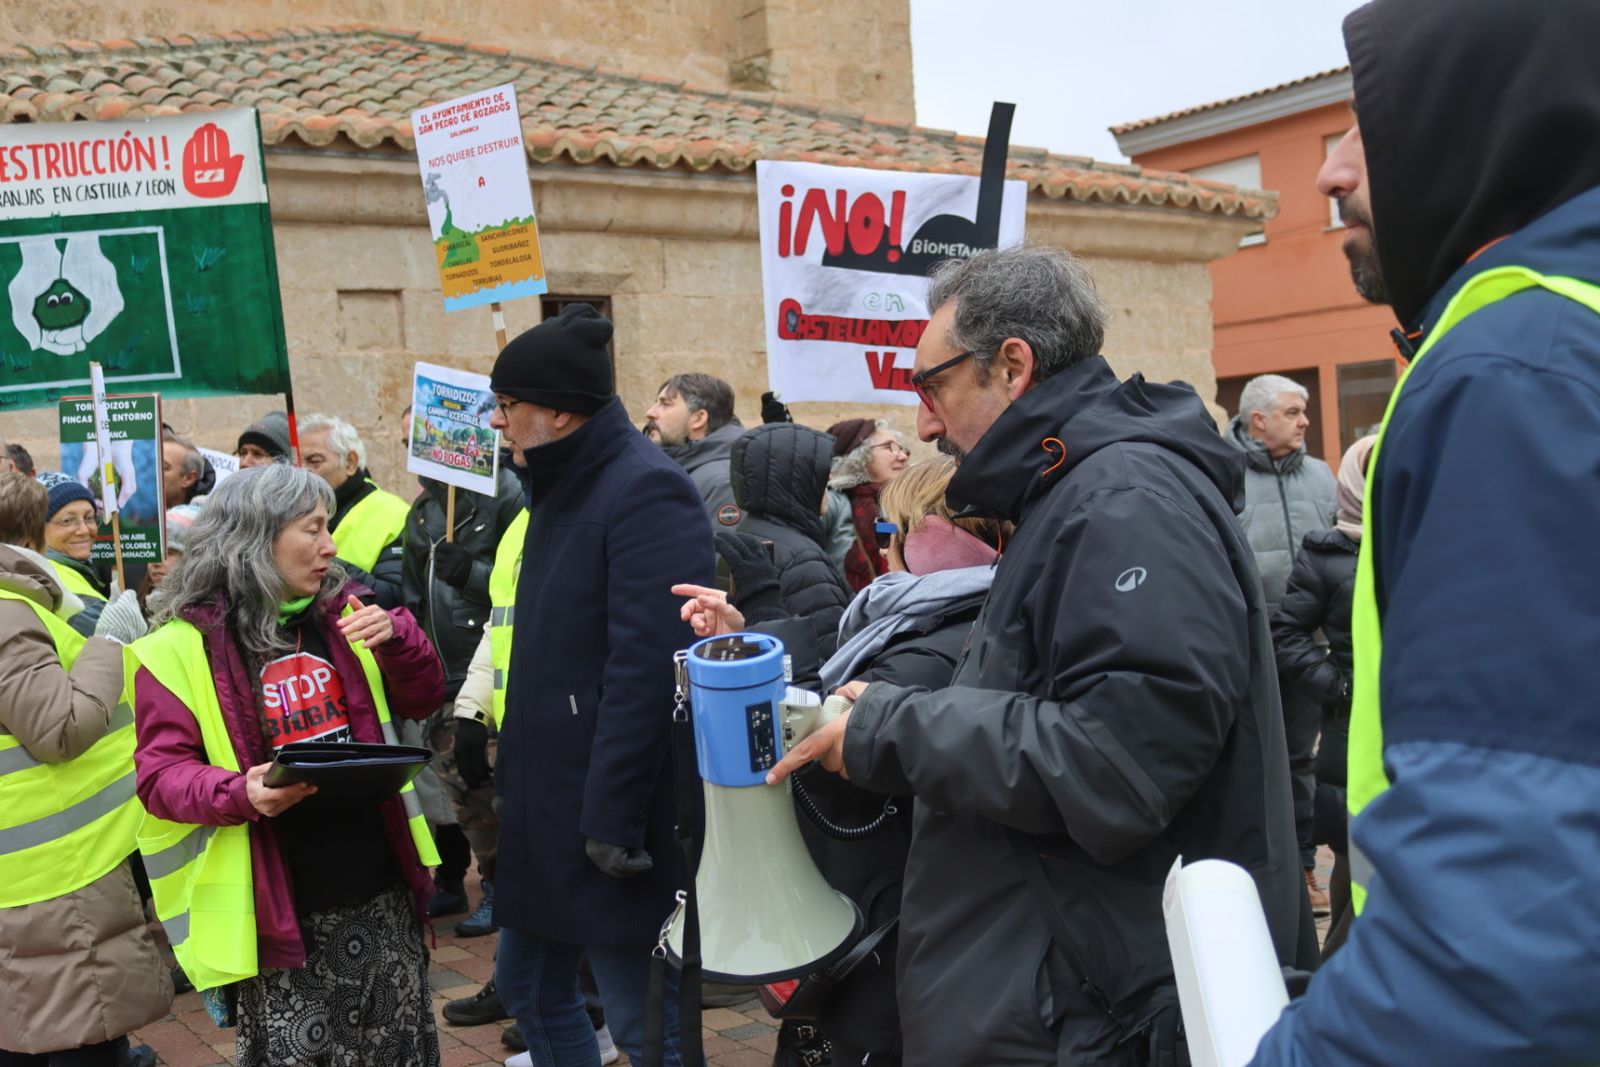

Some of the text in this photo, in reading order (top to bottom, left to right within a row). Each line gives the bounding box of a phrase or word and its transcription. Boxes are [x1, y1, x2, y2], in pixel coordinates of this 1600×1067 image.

[420, 92, 504, 124] EL AYUNTAMIENTO DE
[418, 101, 511, 136] SAN PEDRO DE ROZADOS
[449, 125, 480, 139] SALAMANCA
[428, 136, 520, 169] NOS QUIERE DESTRUIR
[53, 186, 72, 204] EN
[76, 181, 131, 202] CASTILLA
[135, 180, 143, 197] Y
[478, 176, 486, 188] A
[863, 292, 906, 312] en
[131, 401, 137, 409] Y
[62, 414, 93, 424] FINCAS
[112, 412, 153, 422] ENTORNO
[131, 533, 146, 541] AIRE
[262, 667, 332, 708] STOP
